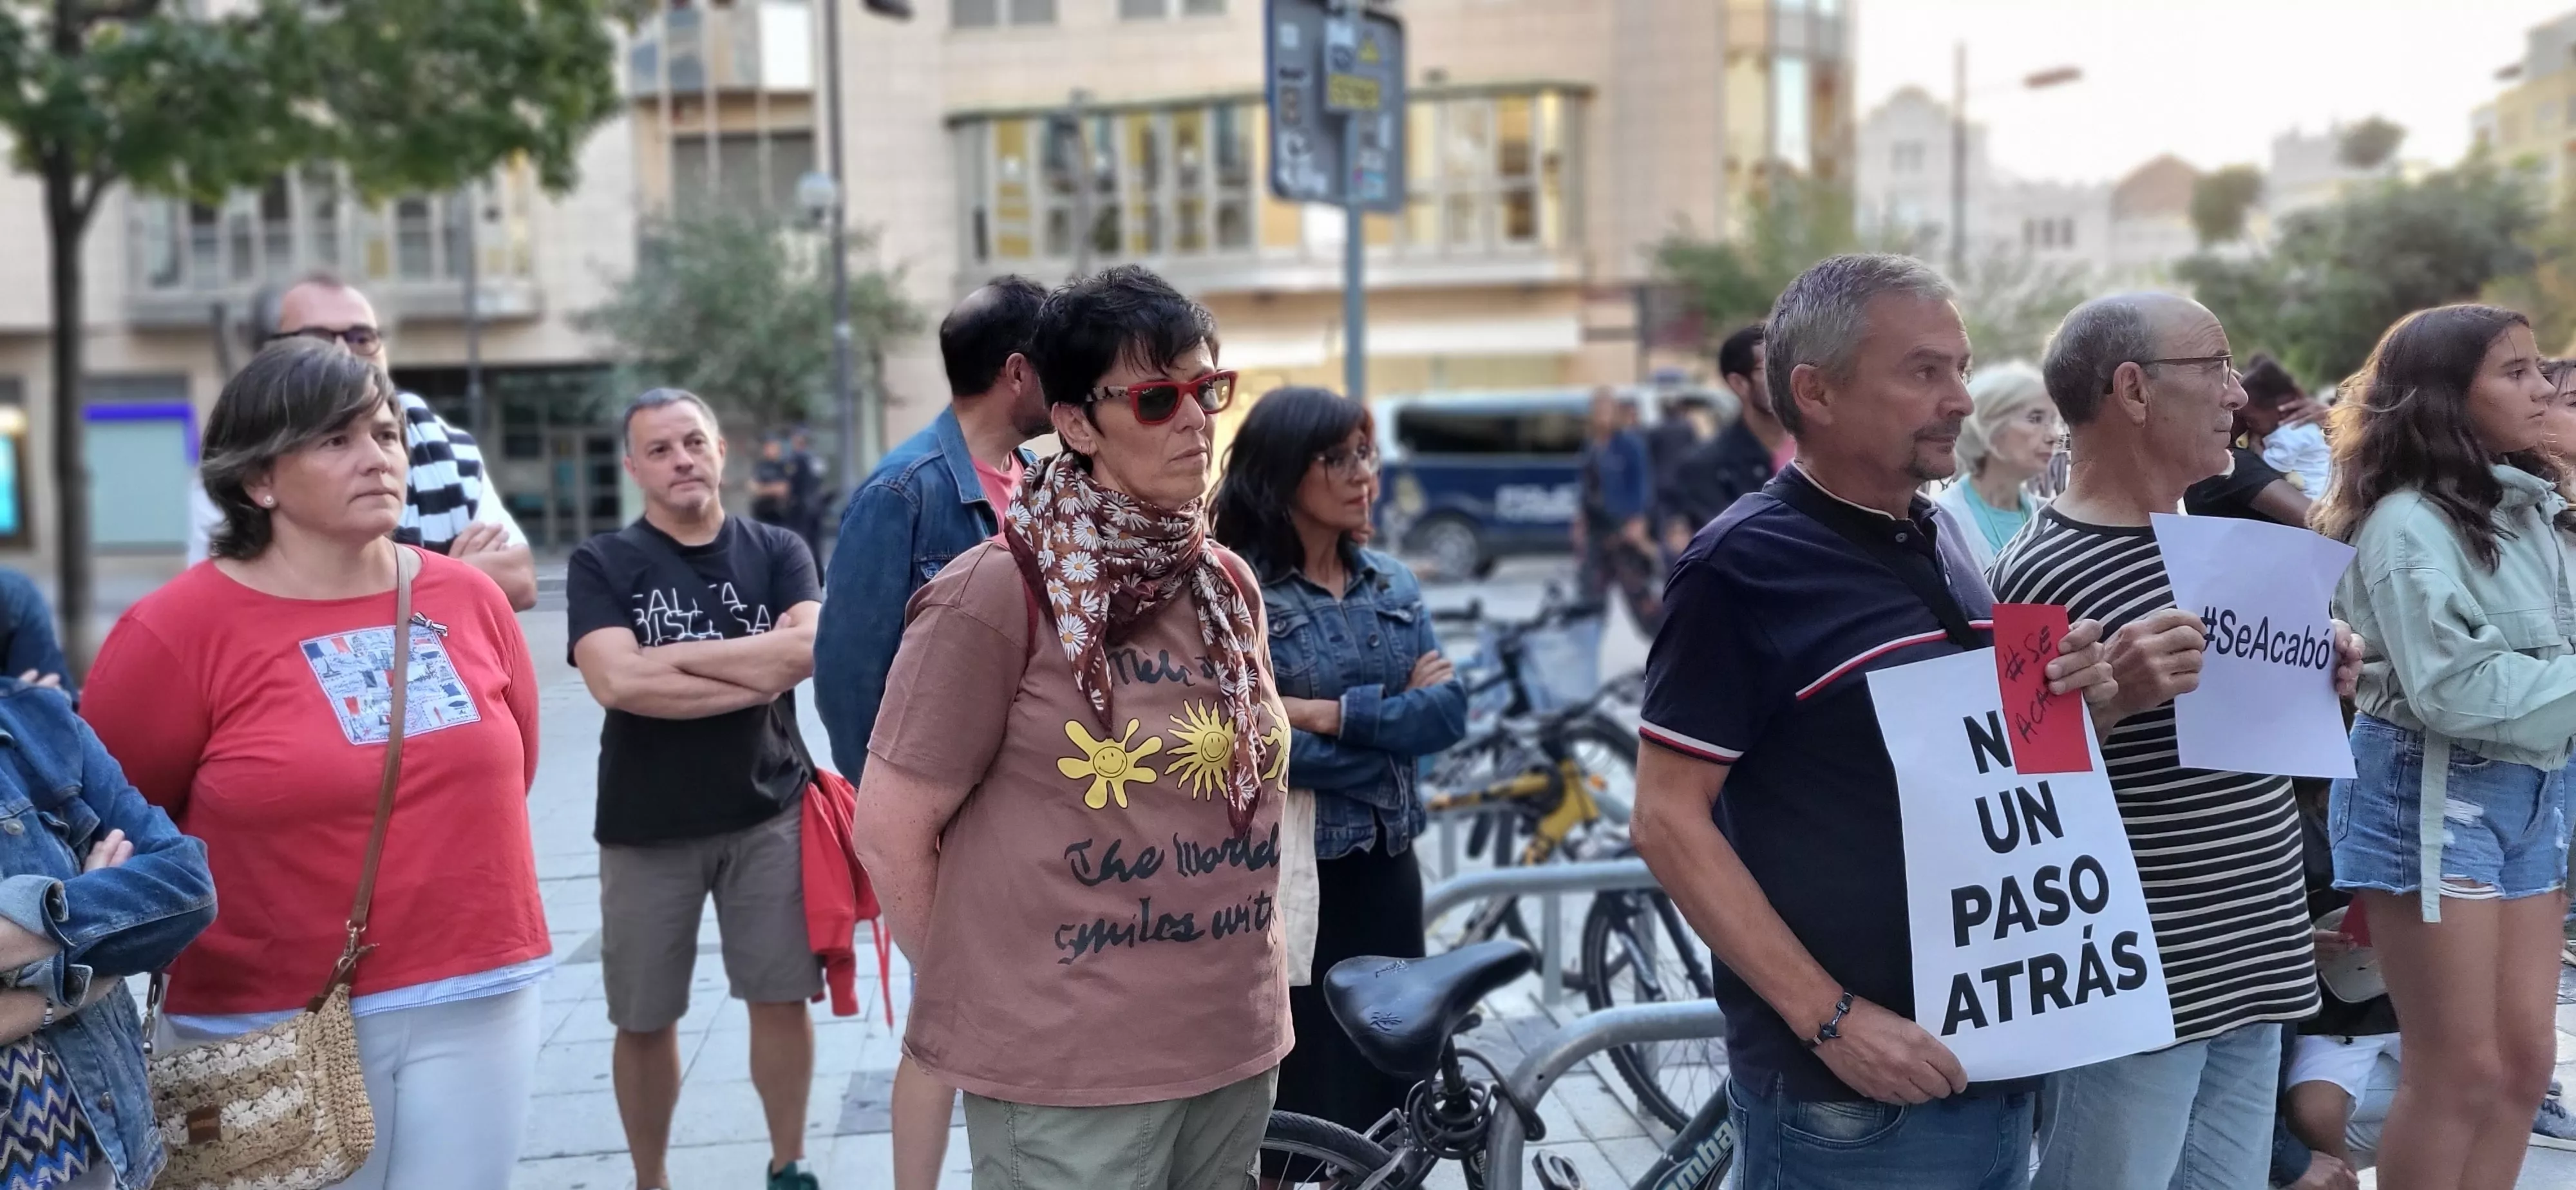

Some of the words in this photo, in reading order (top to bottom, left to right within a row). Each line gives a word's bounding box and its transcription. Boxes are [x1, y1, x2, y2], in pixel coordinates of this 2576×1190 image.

[2200, 606, 2331, 670] #SeAcabó
[1963, 710, 2013, 775] N
[2015, 688, 2054, 744] ACA
[1975, 780, 2064, 855] UN
[1063, 838, 1165, 887] The
[1054, 896, 1206, 965] smiles
[1951, 854, 2110, 949] PASO
[1940, 923, 2148, 1037] ATRÁS
[1663, 1120, 1734, 1190] mba
